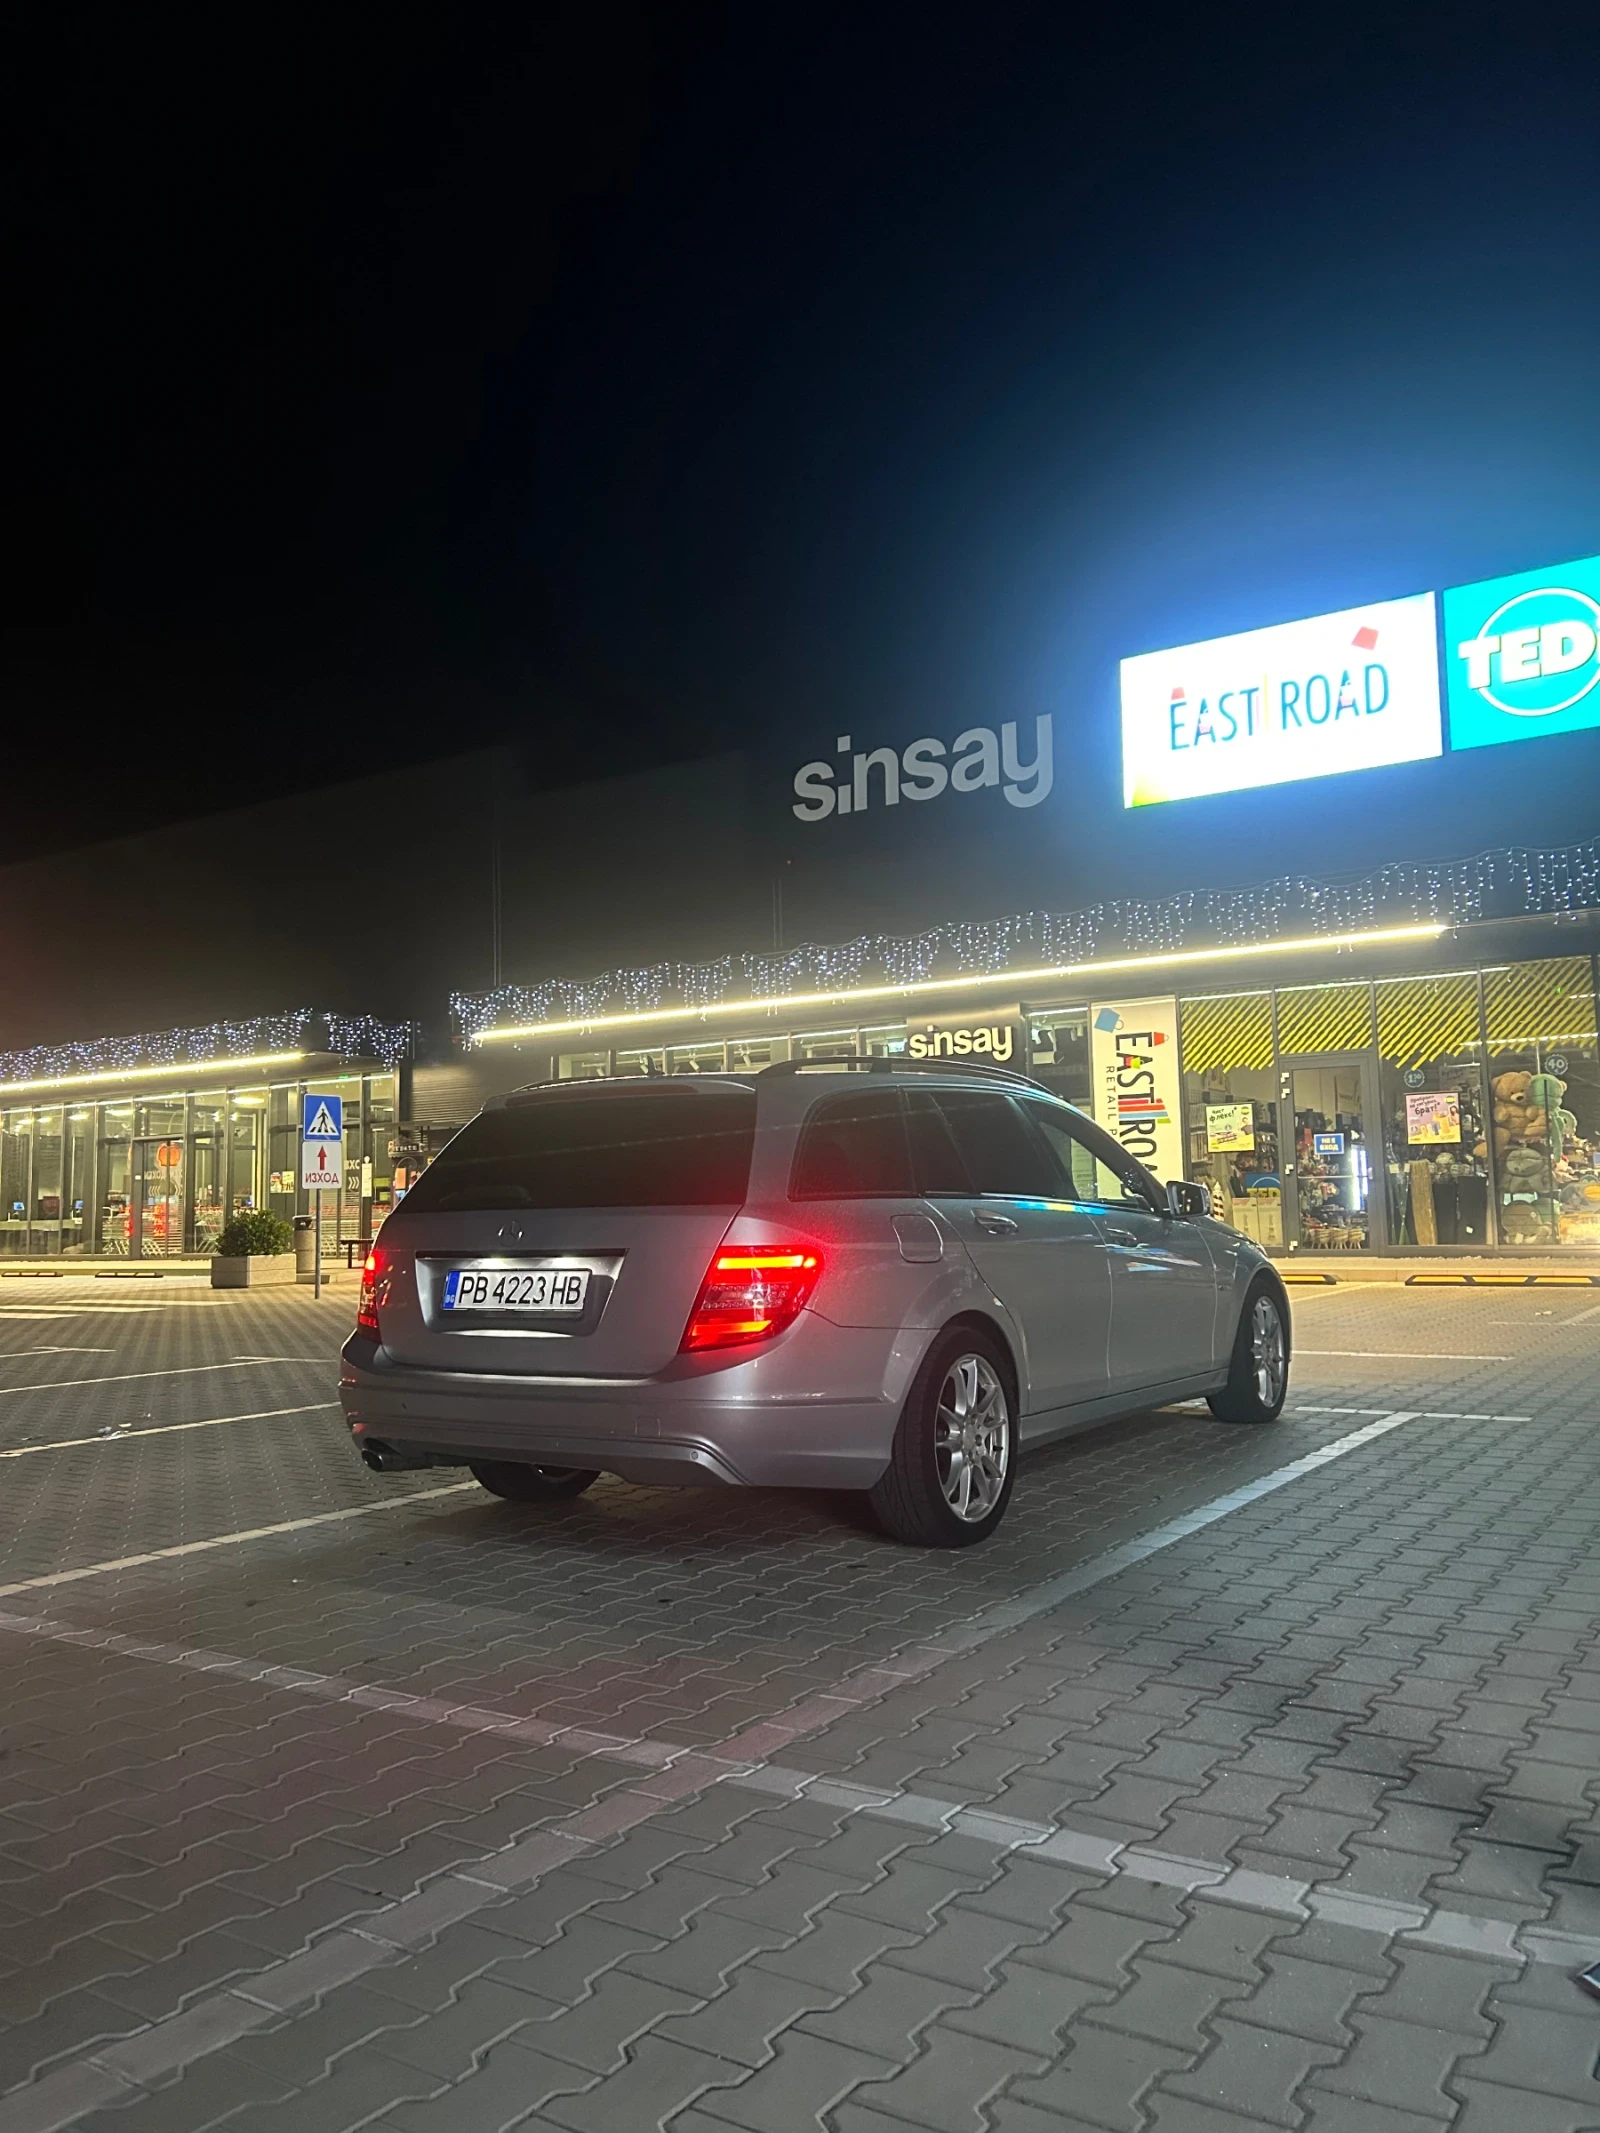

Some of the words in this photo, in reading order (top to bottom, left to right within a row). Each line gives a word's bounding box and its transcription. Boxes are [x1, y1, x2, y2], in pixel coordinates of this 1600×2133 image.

[1458, 619, 1600, 690] TED
[1170, 686, 1260, 750] EAST
[1280, 663, 1390, 730] ROAD
[792, 713, 1054, 822] sinsay
[909, 1024, 1013, 1062] sinsay
[1115, 1031, 1155, 1104] EAST
[1105, 1065, 1118, 1121] RETAIL
[1118, 1118, 1158, 1173] RO
[305, 1172, 340, 1185] ИЗХОД
[458, 1276, 489, 1304] PB
[493, 1276, 547, 1305] 4223
[550, 1276, 583, 1305] HB
